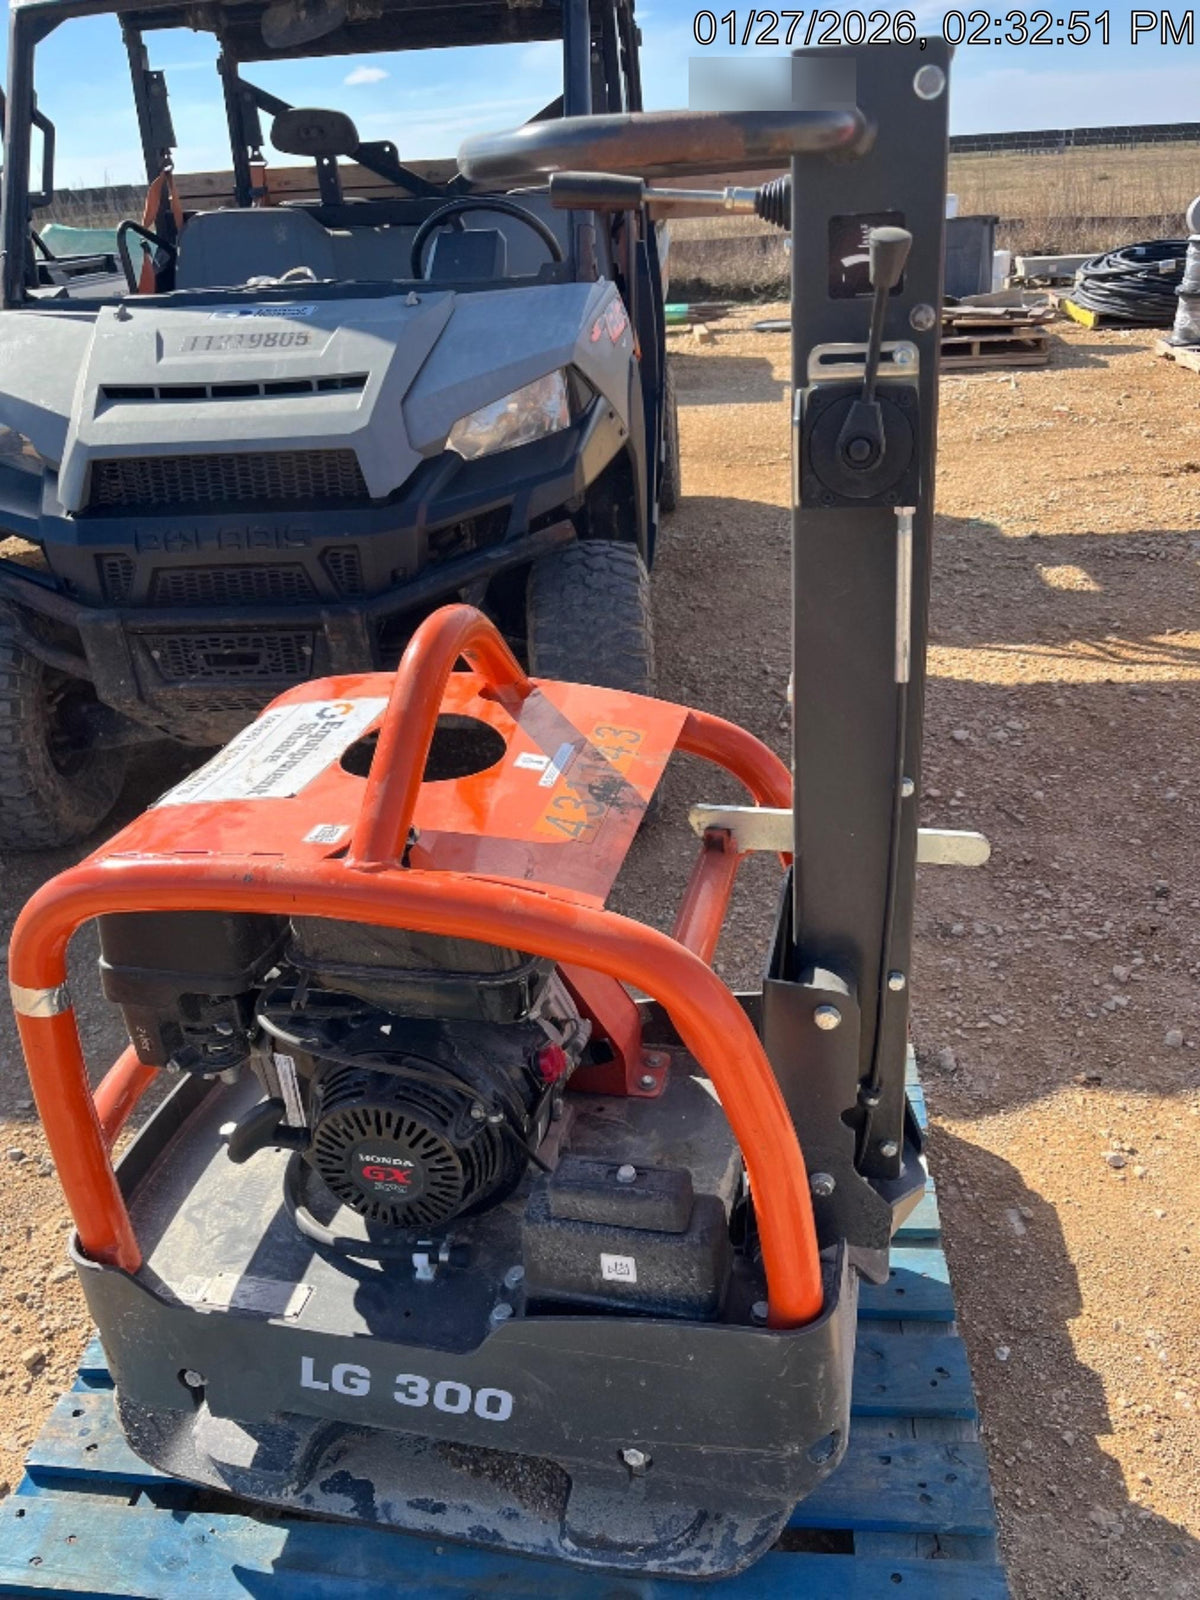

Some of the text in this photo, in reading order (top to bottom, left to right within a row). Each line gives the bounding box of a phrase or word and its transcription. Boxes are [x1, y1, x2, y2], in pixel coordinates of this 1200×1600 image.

[263, 722, 319, 763] Share
[358, 1153, 415, 1167] HONDA
[362, 1165, 413, 1185] GX
[300, 1356, 513, 1422] LG 300
